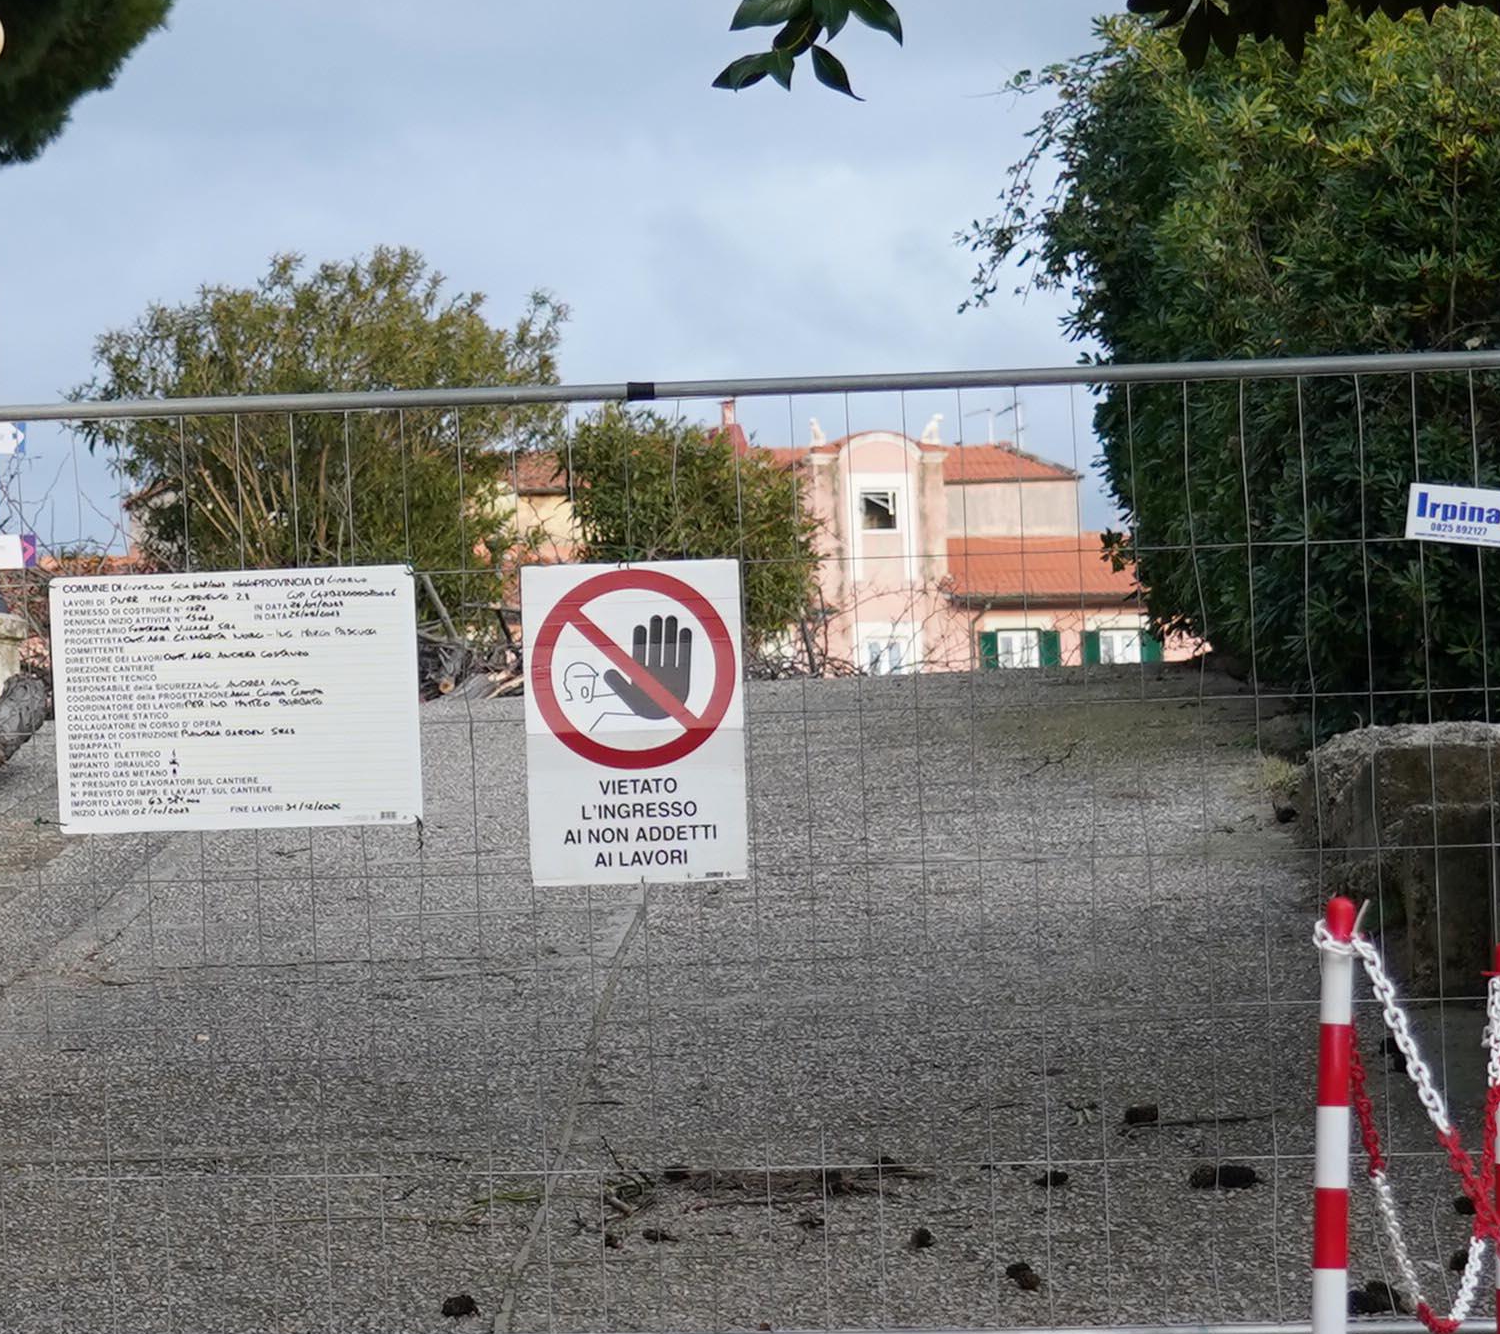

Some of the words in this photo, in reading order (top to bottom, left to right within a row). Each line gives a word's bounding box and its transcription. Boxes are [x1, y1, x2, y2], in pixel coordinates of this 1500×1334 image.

[1416, 492, 1500, 524] Irpina
[1431, 523, 1453, 533] 0825
[1456, 525, 1487, 535] 892127
[63, 584, 109, 593] COMUNE
[112, 583, 122, 592] DI
[254, 577, 312, 587] PROVINCIA
[314, 577, 325, 586] DI
[63, 599, 94, 607] LAVORI
[123, 607, 171, 615] COSTRUIRE
[63, 618, 106, 626] DENUNCIA
[109, 617, 133, 625] INIZIO
[64, 628, 127, 636] PROPRIETARIO
[64, 637, 123, 645] PROGETTISTA
[65, 647, 124, 655] COMMITTENTE
[65, 656, 113, 665] DIRETTORE
[131, 655, 162, 663] LAVORI
[113, 665, 155, 673] CANTIERE
[66, 676, 117, 684] ASSISTENTE
[67, 685, 130, 693] RESPONSABILE
[155, 683, 201, 691] SICUREZZA
[67, 695, 133, 703] COORDINATORE
[158, 692, 228, 700] PROGETTAZIONE
[67, 704, 134, 713] COORDINATORE
[152, 702, 184, 710] LAVORI
[67, 714, 130, 722] CALCOLATORE
[132, 712, 168, 720] STATICO
[68, 723, 135, 732] COLLAUDATORE
[150, 721, 179, 729] CORSO
[68, 733, 105, 741] IMPRESA
[119, 731, 178, 739] COSTRUZIONE
[69, 742, 121, 750] SUBAPPALTI
[69, 752, 109, 760] IMPIANTO
[114, 750, 161, 759] ELETTRICO
[70, 761, 109, 769] IMPIANTO
[115, 760, 160, 768] IDRAULICO
[70, 771, 110, 779] IMPIANTO
[113, 770, 130, 778] GAS
[133, 769, 168, 777] METANO
[82, 780, 127, 788] PRESUNTO
[129, 779, 138, 787] DI
[140, 778, 195, 786] LAVORATORI
[198, 777, 213, 785] SUL
[216, 777, 258, 785] CANTIERE
[599, 778, 677, 795] VIETATO
[83, 789, 123, 797] PREVISTO
[126, 789, 135, 797] DI
[212, 786, 227, 794] SUL
[230, 786, 272, 794] CANTIERE
[71, 800, 109, 808] IMPORTO
[112, 799, 143, 807] LAVORI
[99, 808, 130, 816] LAVORI
[230, 805, 250, 813] FINE
[582, 801, 697, 820] L'INGRESSO
[564, 829, 581, 844] AI
[588, 827, 628, 844] NON
[636, 824, 717, 842] ADDETTI
[595, 852, 612, 867] AI
[619, 849, 688, 866] LAVORI
